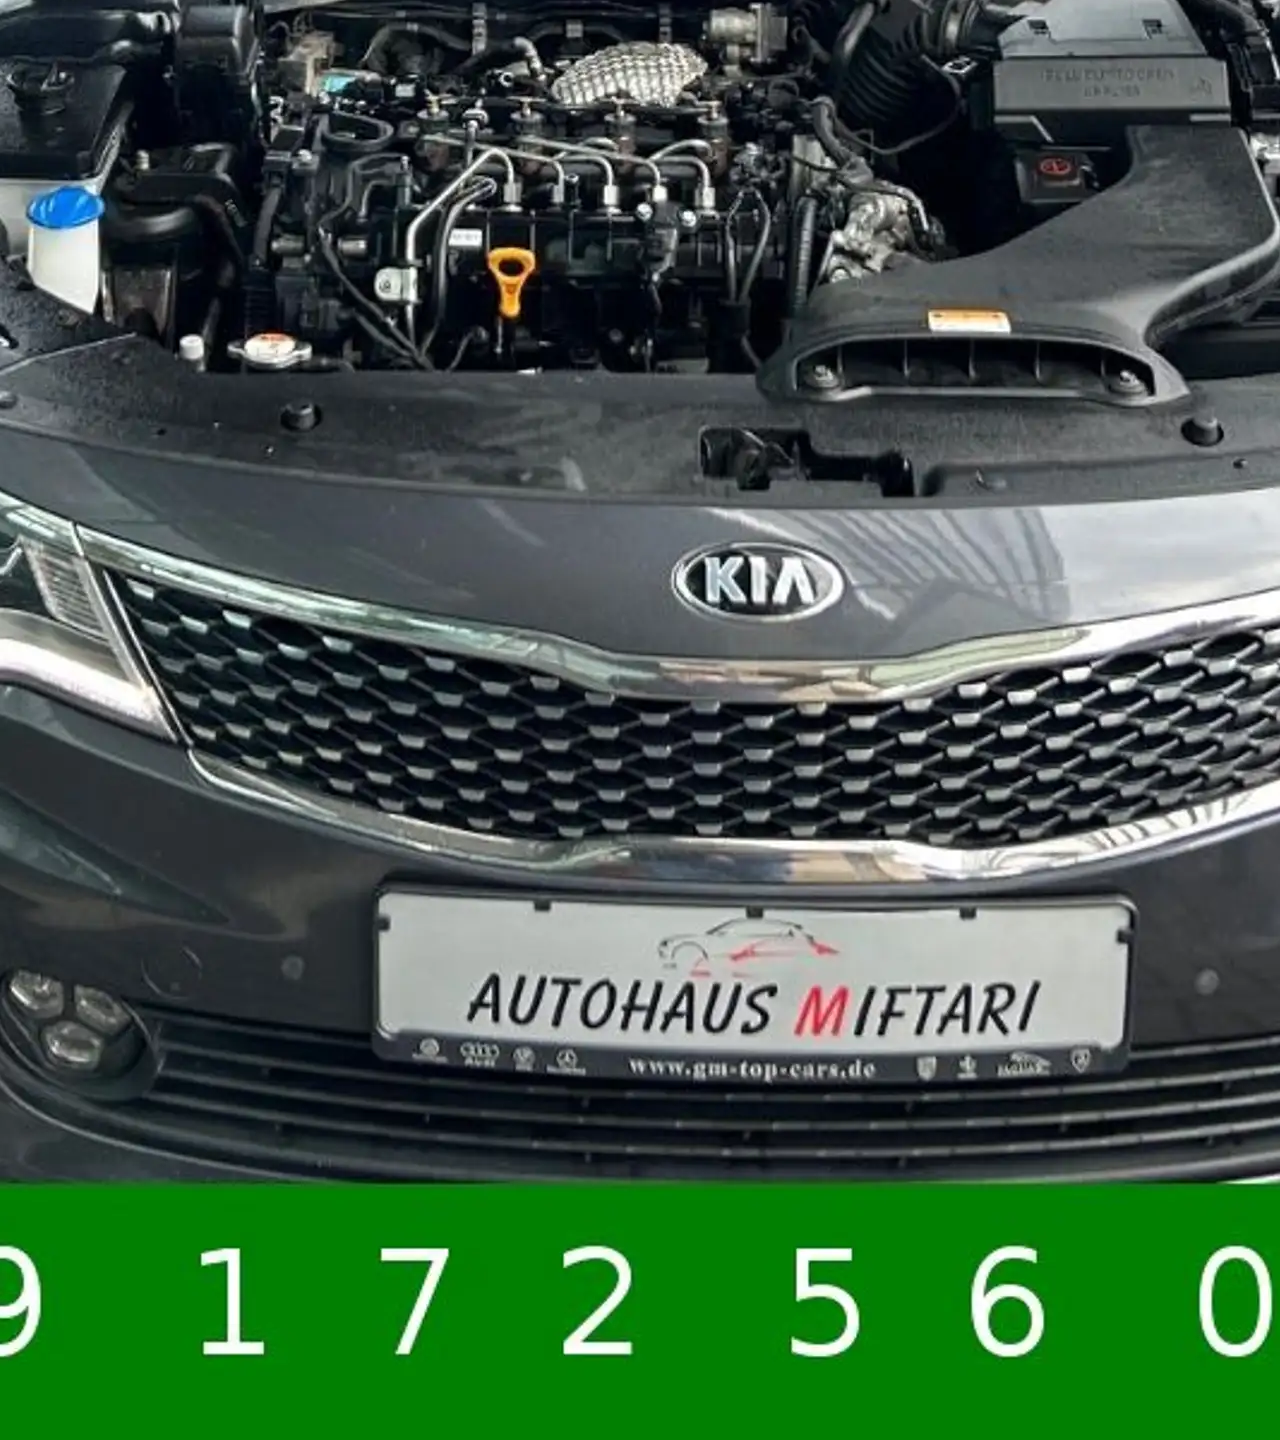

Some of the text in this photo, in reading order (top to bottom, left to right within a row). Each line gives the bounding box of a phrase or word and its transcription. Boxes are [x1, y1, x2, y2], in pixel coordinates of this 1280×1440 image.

[704, 556, 816, 606] KIA
[466, 972, 1042, 1037] AUTOHAUS MIFTARI
[628, 1058, 877, 1085] www.gm-top-cars.de
